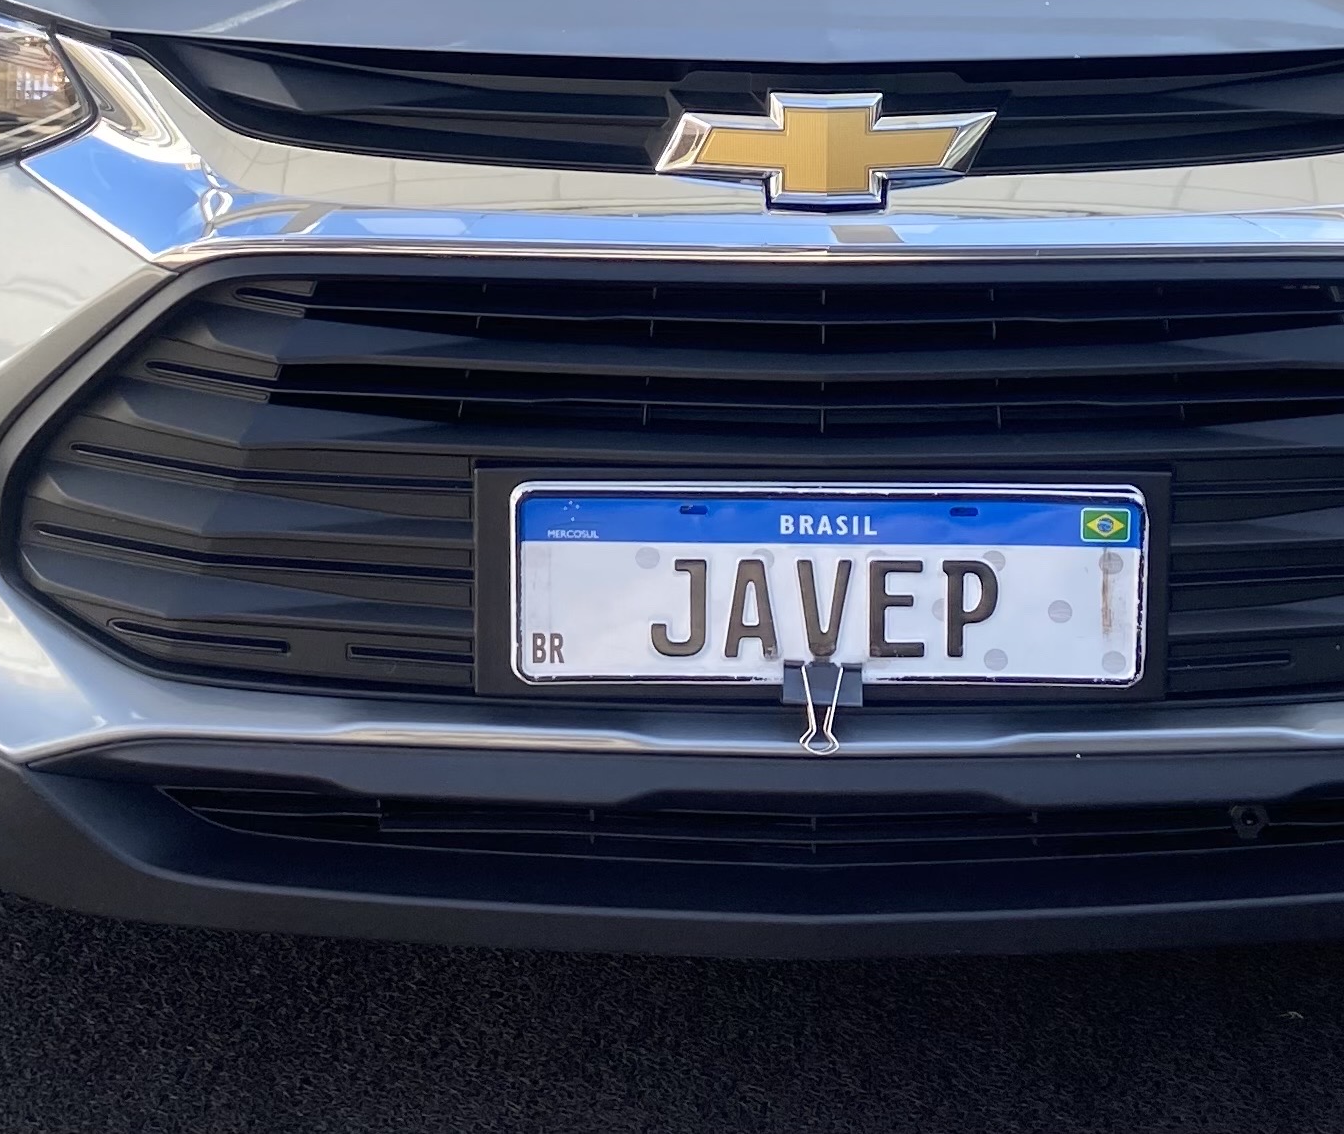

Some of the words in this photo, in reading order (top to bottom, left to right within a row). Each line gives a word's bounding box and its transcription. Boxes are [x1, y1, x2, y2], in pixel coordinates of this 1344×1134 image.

[547, 529, 600, 539] MERCOSUL
[779, 514, 878, 537] BRASIL
[650, 557, 999, 659] JAVEP
[532, 632, 565, 664] BR
